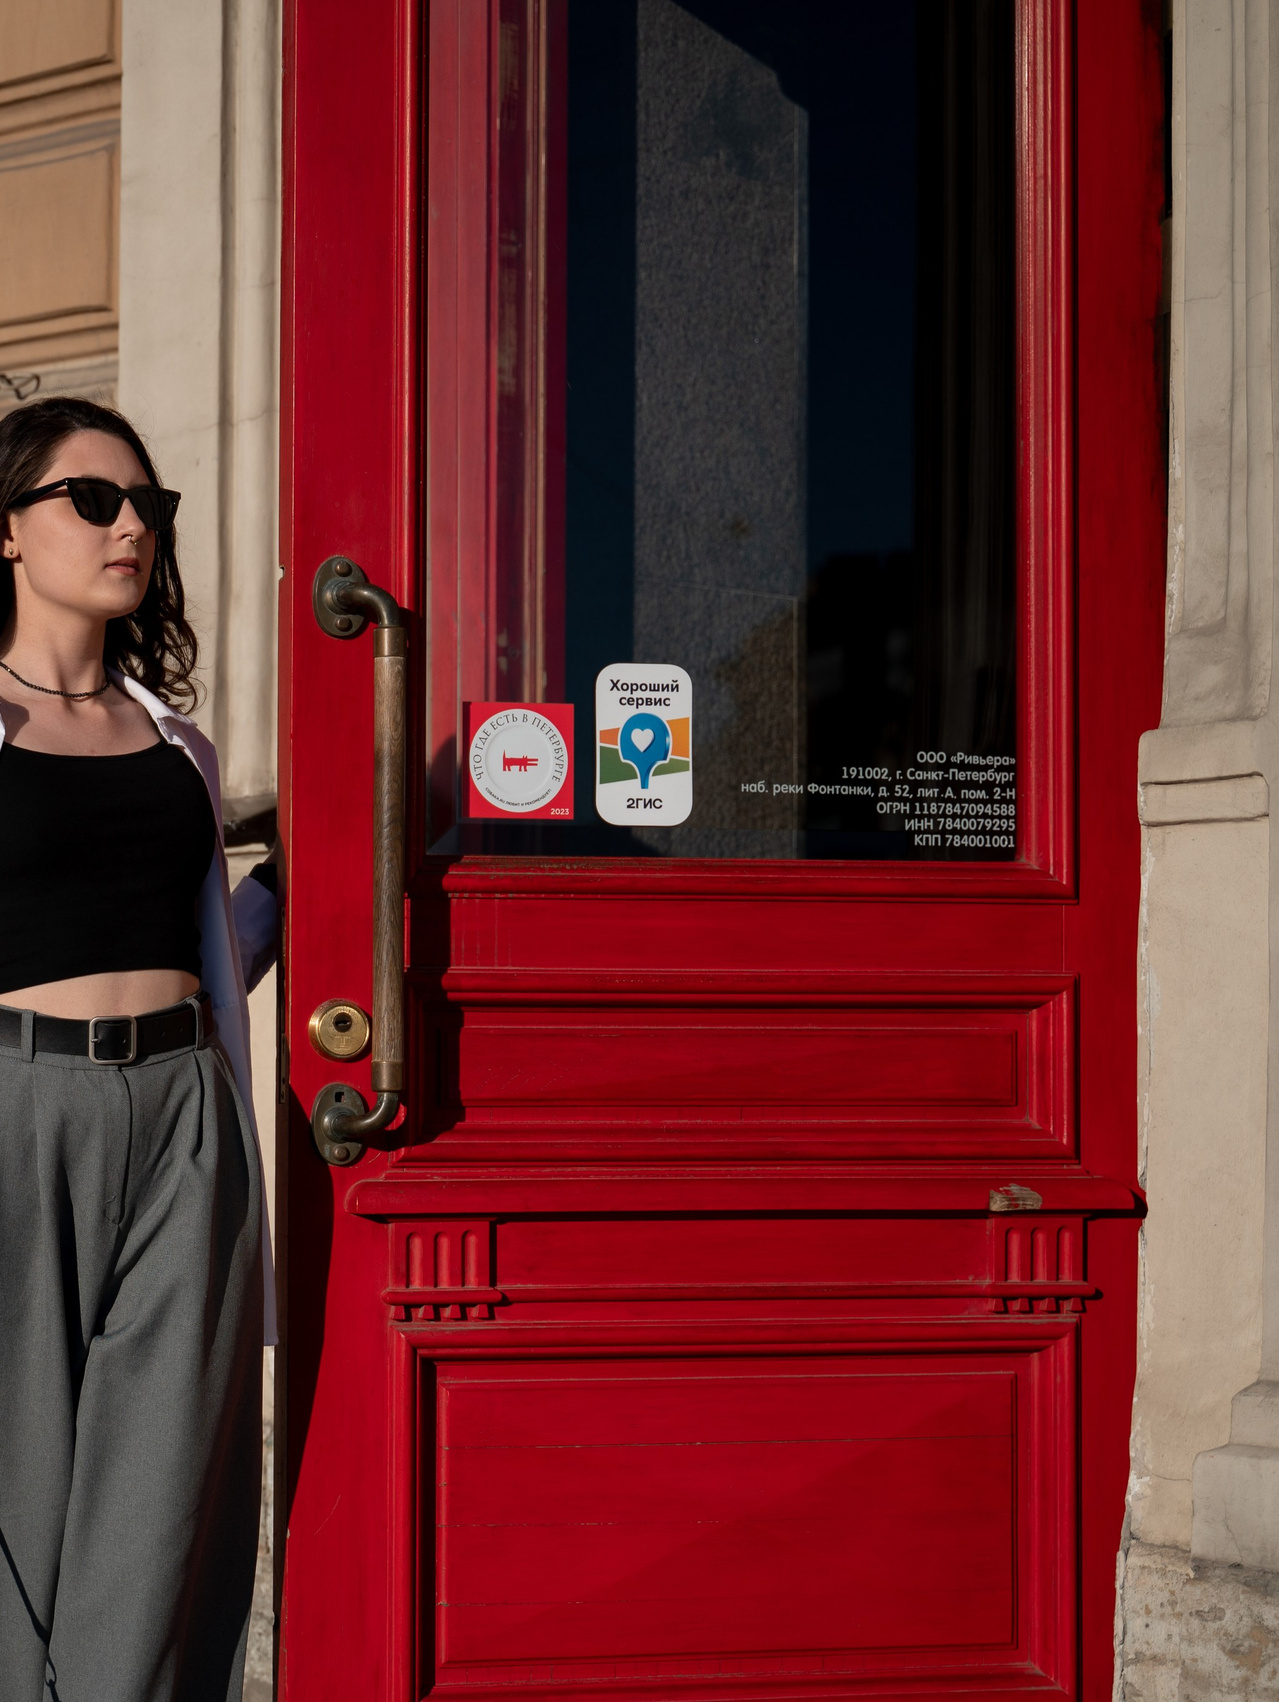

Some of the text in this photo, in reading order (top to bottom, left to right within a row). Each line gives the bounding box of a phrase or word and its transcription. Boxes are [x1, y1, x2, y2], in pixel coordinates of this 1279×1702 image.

[609, 679, 680, 695] Хороший
[618, 696, 671, 709] сервис
[472, 713, 565, 783] ЧТО ГДЕ ЕСТЬ В ПЕТЕРБУРГЕ
[916, 751, 1016, 769] ООО «Ривьера»
[842, 766, 1015, 784] 191002, г. Санкт-Петербург
[741, 780, 769, 793] наб.
[773, 783, 803, 796] реки
[807, 783, 875, 798] Фонтанки,
[878, 787, 890, 797] д.
[894, 785, 913, 798] 52,
[961, 788, 989, 800] пом.
[993, 787, 1016, 800] 2-Н
[626, 797, 663, 809] 2ГИС
[876, 802, 1016, 816] ОГРН 1187847094588
[550, 808, 570, 816] 2023
[905, 817, 1016, 831] ИНН 7840079295
[914, 834, 1015, 848] КПП 784001001
